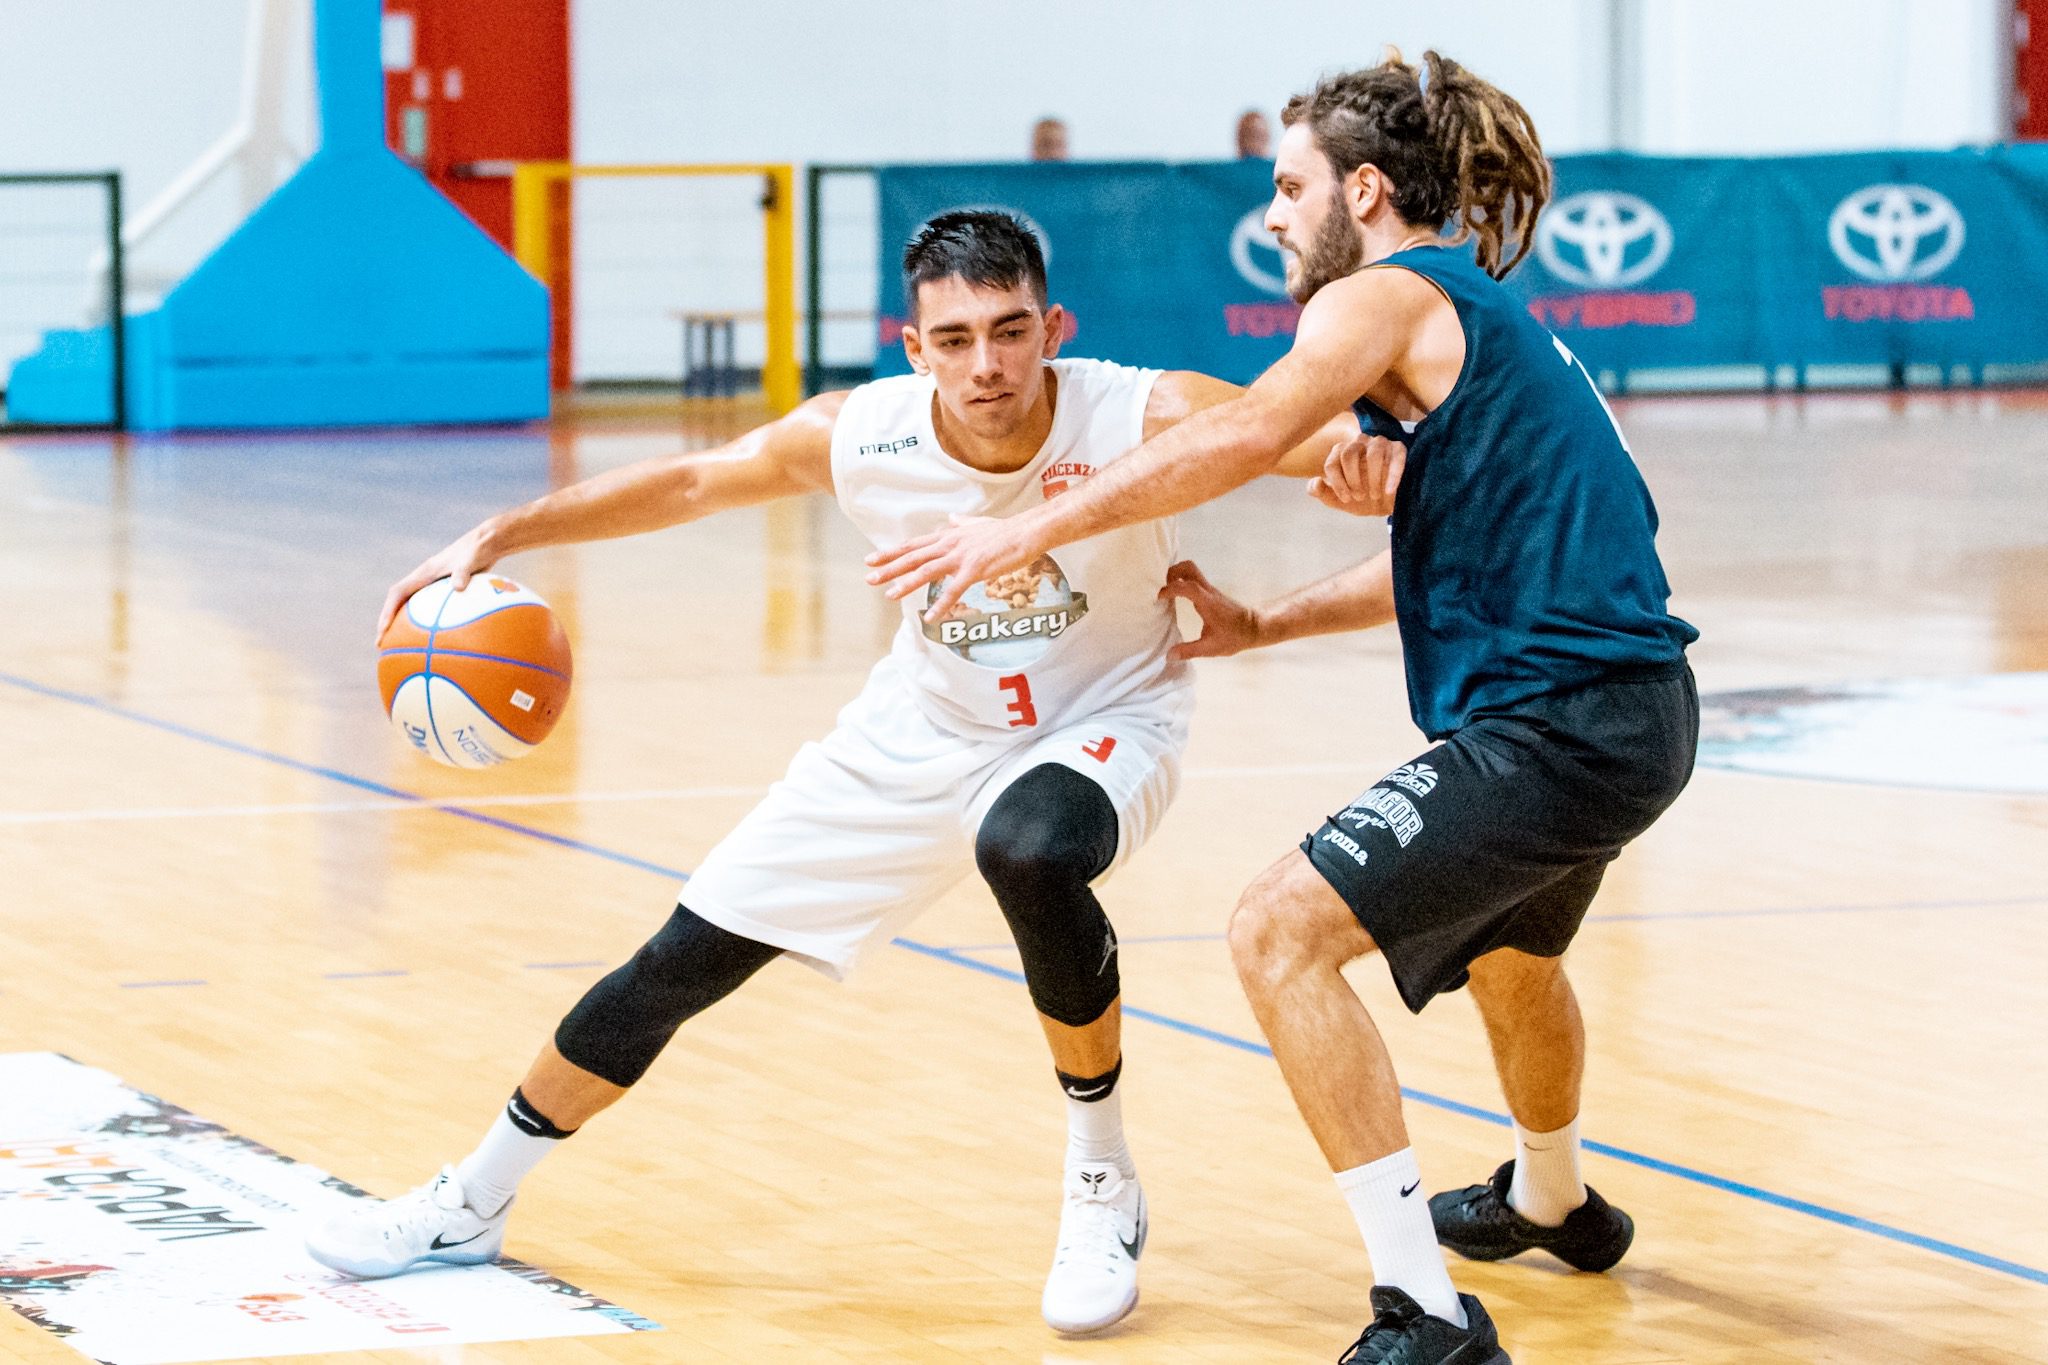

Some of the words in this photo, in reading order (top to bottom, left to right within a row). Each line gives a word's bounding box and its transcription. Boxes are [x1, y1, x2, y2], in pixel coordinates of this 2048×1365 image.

[859, 436, 918, 455] maps
[940, 611, 1068, 644] Bakery
[999, 673, 1037, 727] 3
